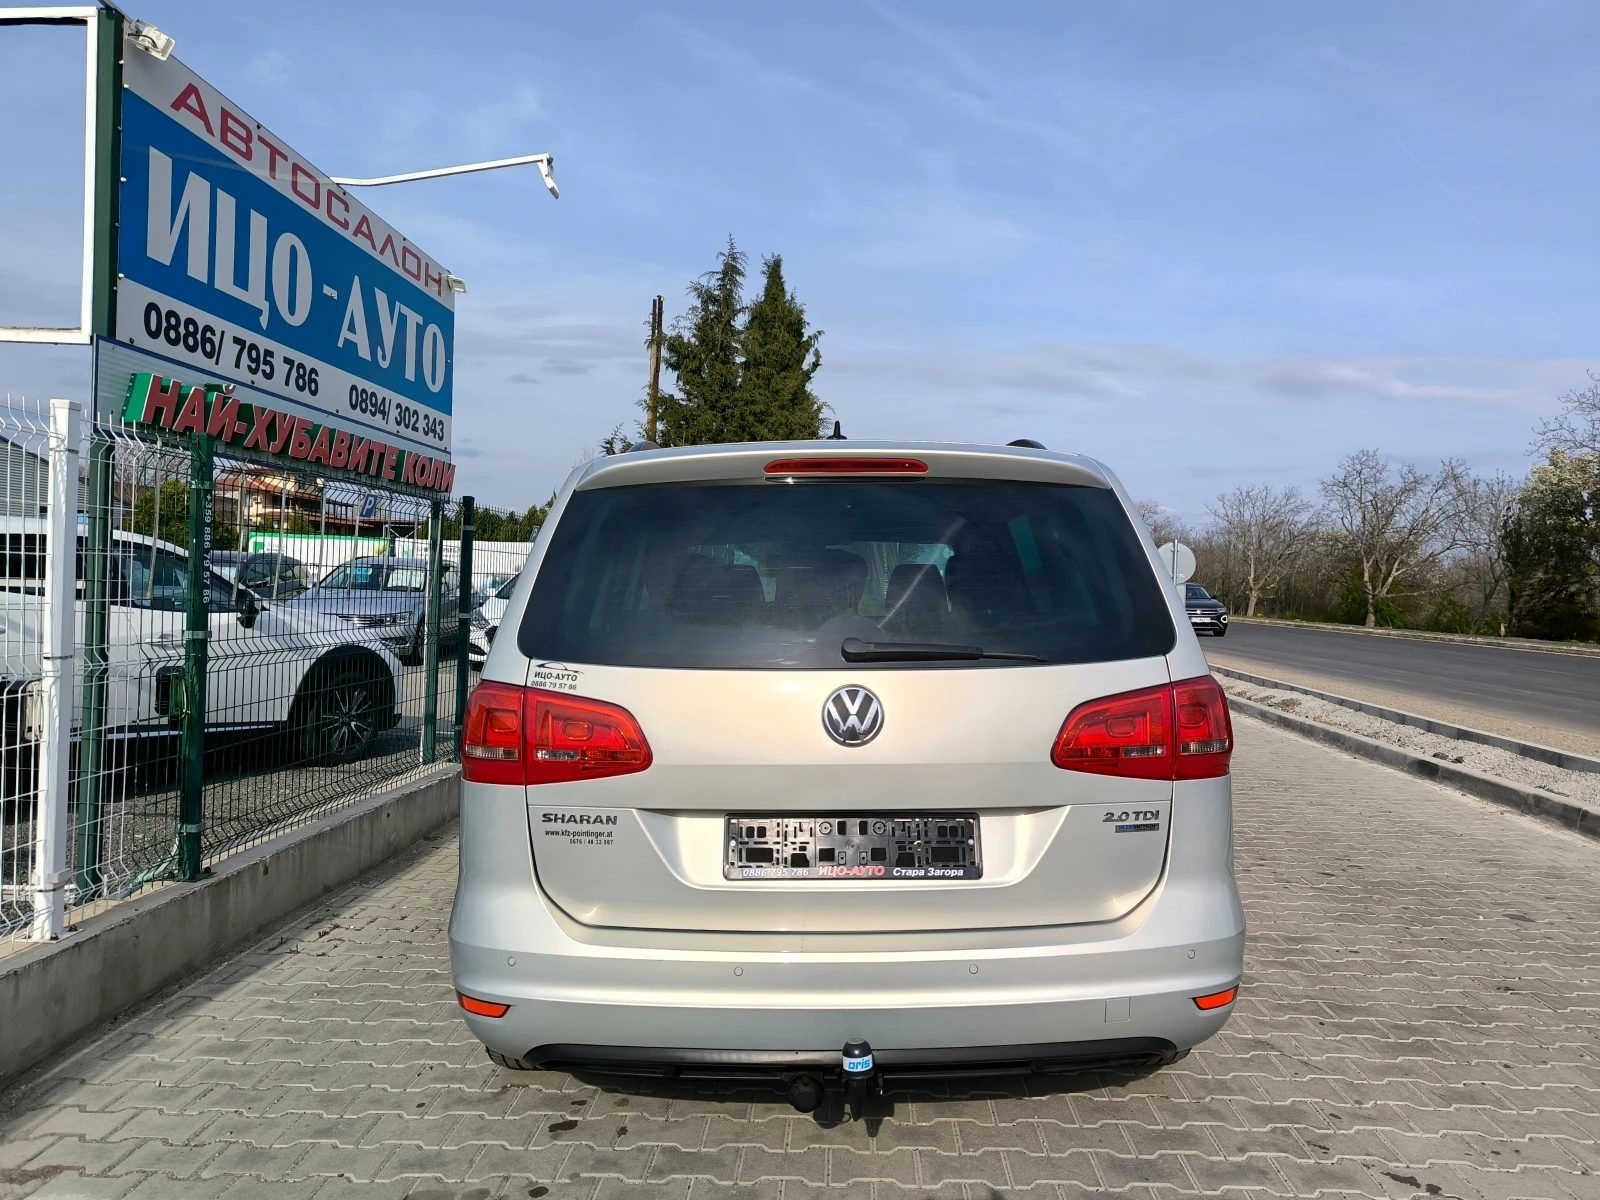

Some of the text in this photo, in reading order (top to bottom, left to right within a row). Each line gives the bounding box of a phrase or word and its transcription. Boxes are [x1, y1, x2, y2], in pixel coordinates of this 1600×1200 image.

[170, 82, 443, 298] АВТОСАЛОН
[146, 146, 446, 393] ИЦО-АУТО
[144, 302, 319, 396] 0886/ 795 786
[349, 384, 444, 441] 0894/ 302 343
[141, 373, 456, 493] НАЙ-ХУБАВИТЕ КОЛИ
[203, 527, 211, 549] 886
[203, 553, 211, 567] 79
[203, 573, 210, 585] 57
[202, 589, 210, 603] 86
[534, 671, 578, 682] ИЦО-АУТО
[548, 681, 557, 689] 79
[558, 682, 567, 690] 57
[568, 683, 578, 691] 86
[541, 813, 618, 825] SHARAN
[1102, 810, 1160, 822] 2.0 TDI
[545, 829, 613, 839] www.kfz-pointinger.at
[743, 868, 809, 877] 0886 795 786
[817, 865, 885, 878] ИЦО-АУТО
[893, 867, 964, 877] Стара Загора
[848, 1058, 870, 1070] oris
